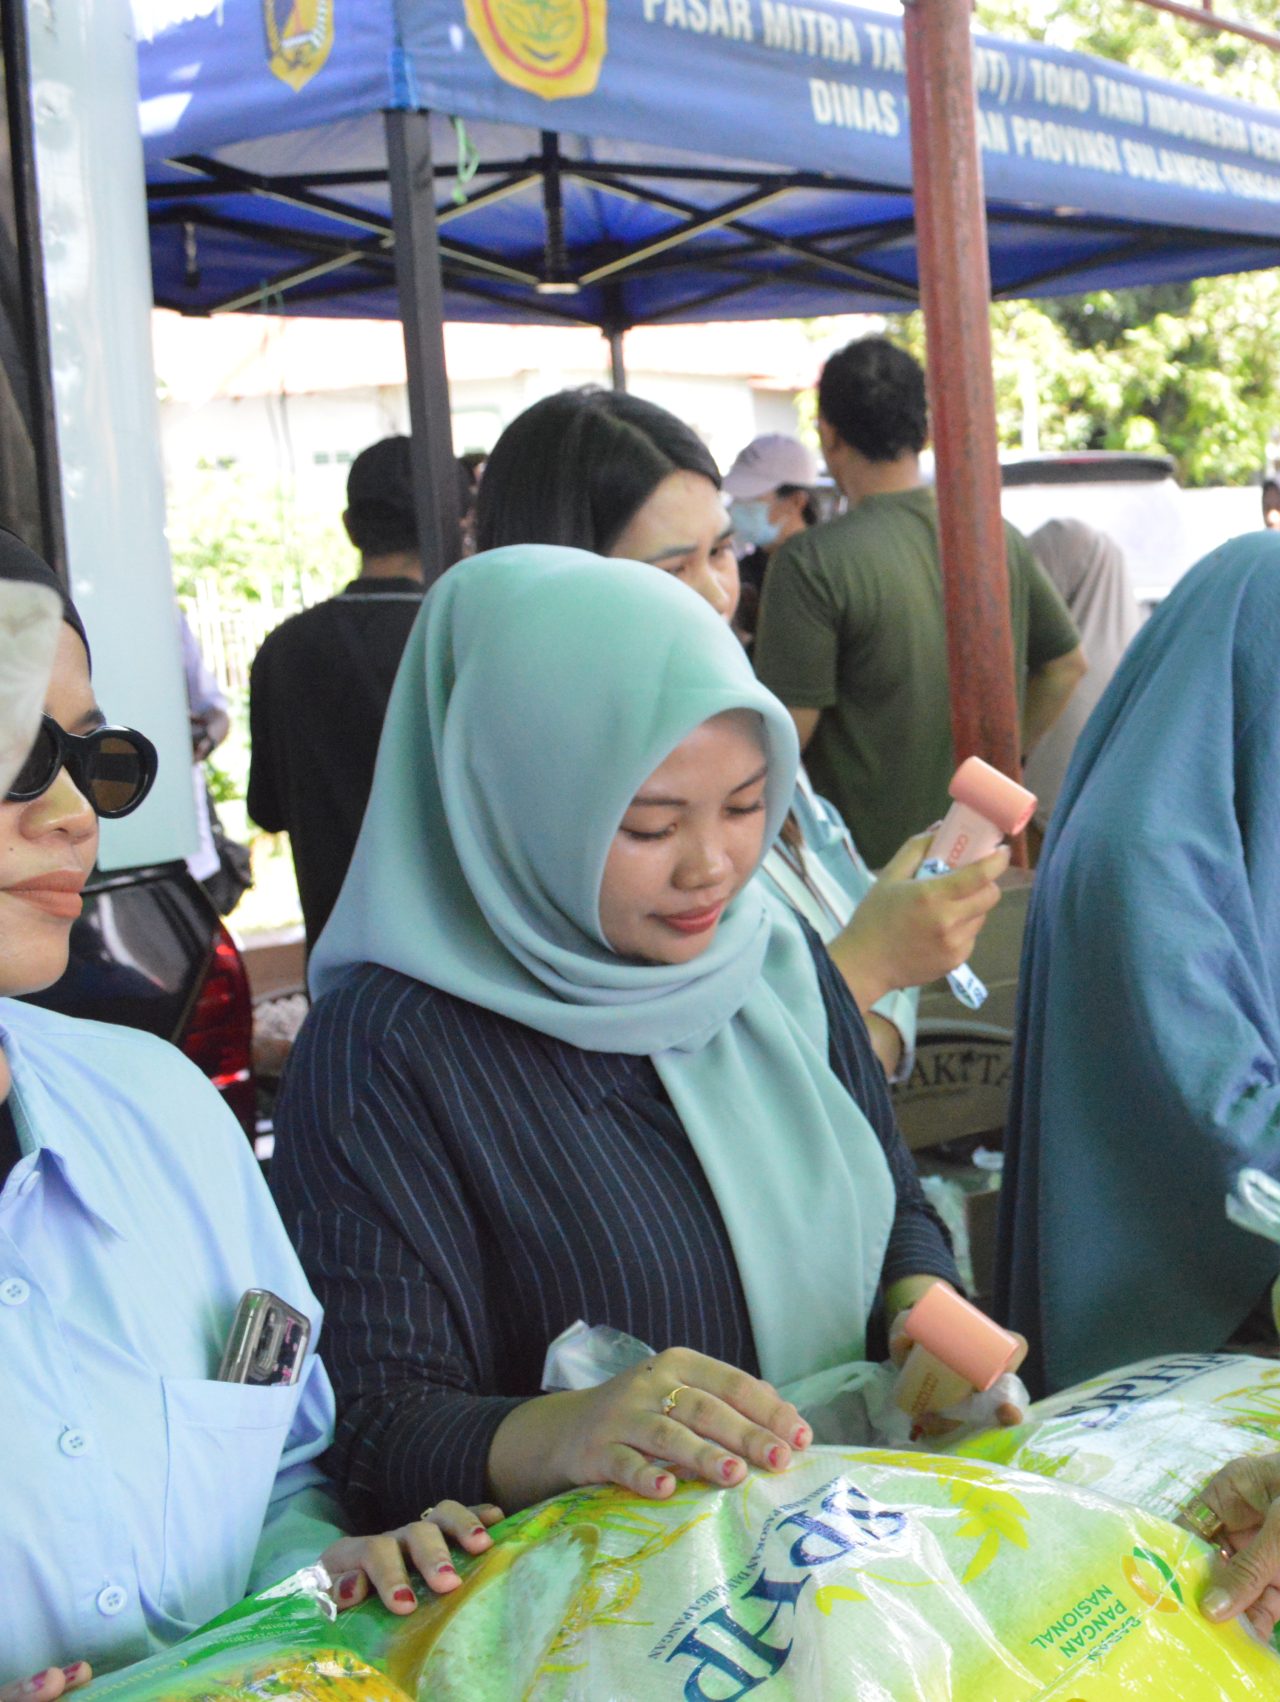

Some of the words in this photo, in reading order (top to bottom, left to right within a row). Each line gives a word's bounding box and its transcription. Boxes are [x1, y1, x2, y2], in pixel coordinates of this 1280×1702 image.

[761, 0, 861, 65] MITRA
[865, 23, 906, 73] TA
[1030, 58, 1091, 114] TOKO
[808, 77, 900, 138] DINAS
[1010, 114, 1123, 175] PROVINSI
[745, 1507, 782, 1570] PASOKAN
[683, 1484, 908, 1702] SPHP
[1029, 1584, 1113, 1649] NASIONAL
[646, 1611, 694, 1660] PANGAN
[1059, 1598, 1128, 1658] PANGAN
